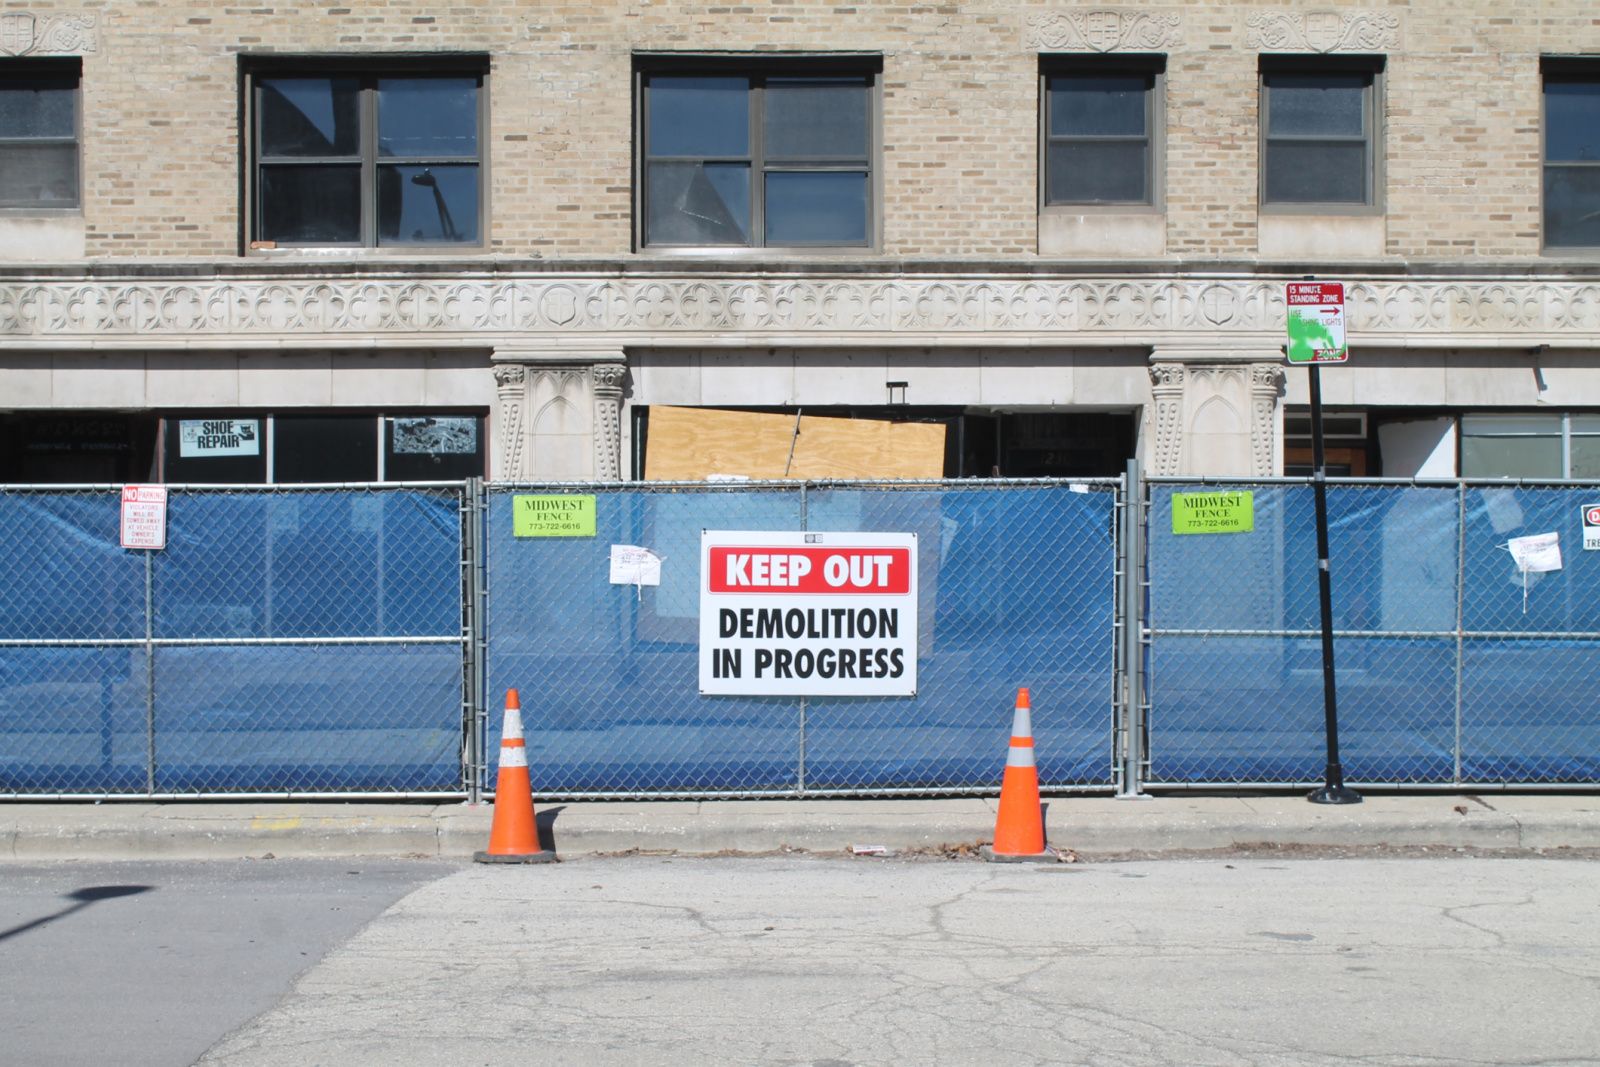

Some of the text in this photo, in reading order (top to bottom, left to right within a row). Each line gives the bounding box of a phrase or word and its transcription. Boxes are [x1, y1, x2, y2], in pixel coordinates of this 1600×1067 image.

[1289, 285, 1321, 294] 15 MINUTE
[1290, 294, 1339, 303] STANDING ZONE
[1321, 318, 1342, 326] LIGHTS
[1316, 350, 1342, 360] ZONE
[203, 421, 234, 434] SHOE
[198, 435, 239, 449] REPAIR
[124, 489, 164, 500] NO PARKING
[524, 499, 585, 511] MIDWEST
[1183, 496, 1243, 509] MIDWEST
[536, 512, 573, 521] FENCE
[1195, 509, 1231, 518] FENCE
[1187, 519, 1239, 528] 773-722-6616
[726, 554, 894, 588] KEEP OUT
[719, 607, 898, 639] DEMOLITION
[712, 648, 905, 679] IN PROGRESS
